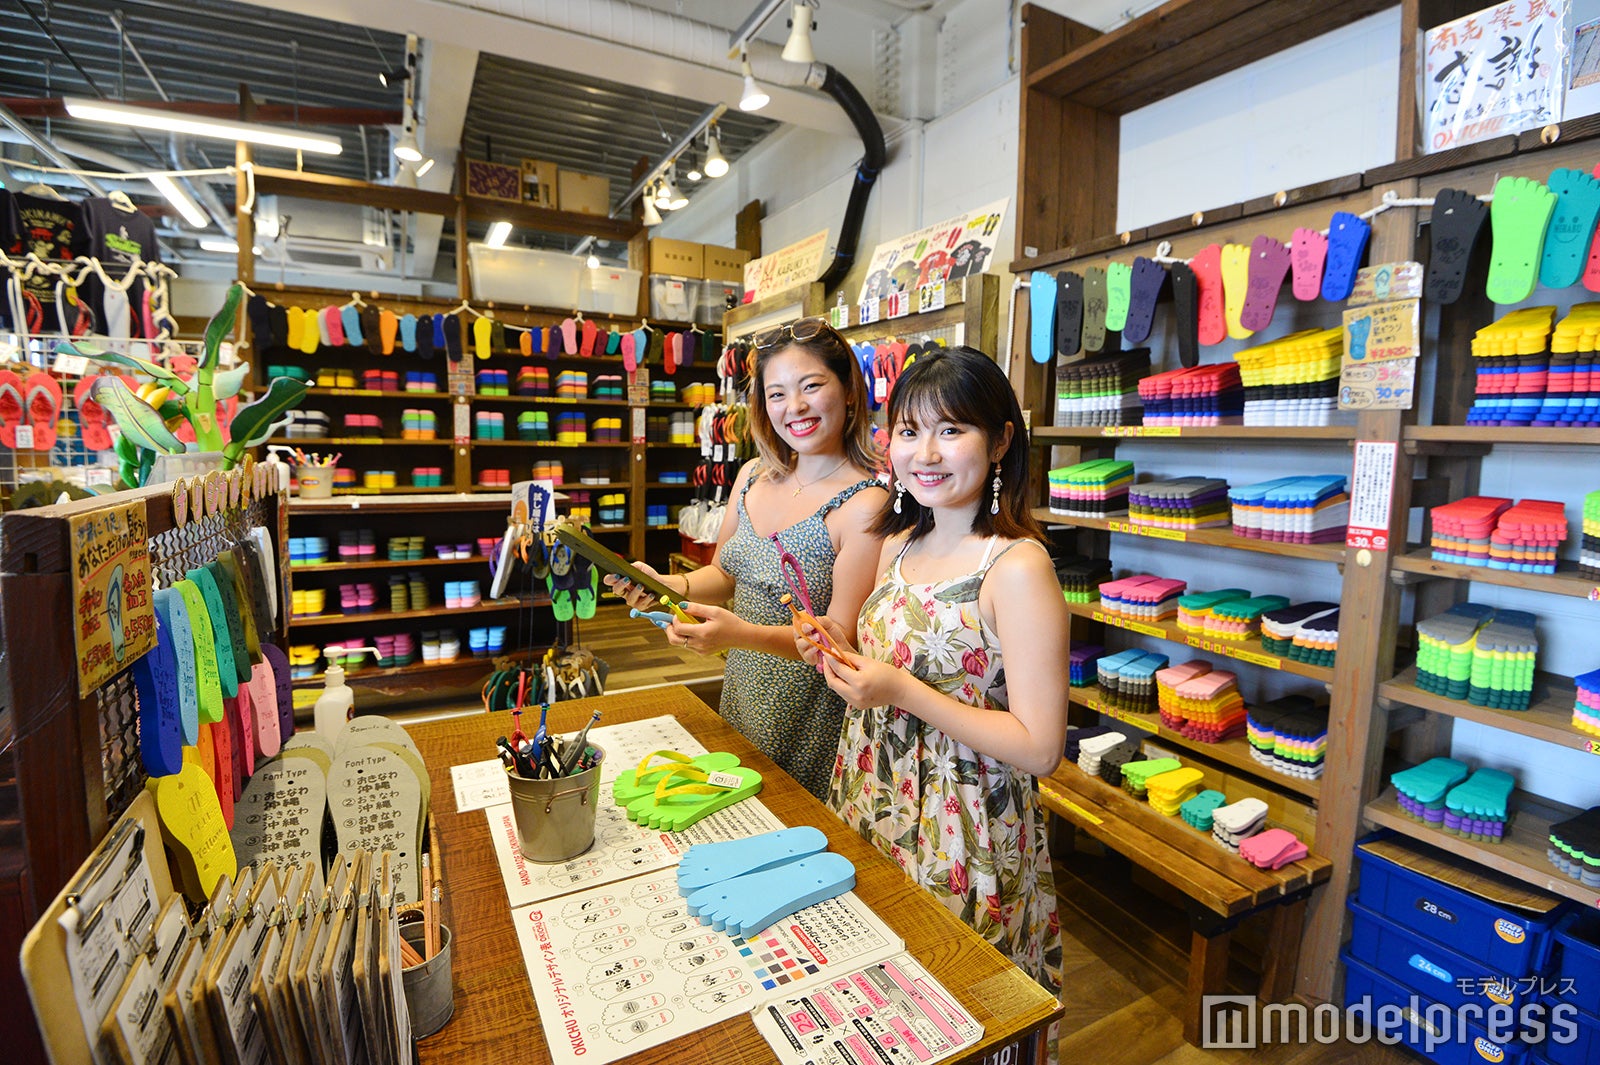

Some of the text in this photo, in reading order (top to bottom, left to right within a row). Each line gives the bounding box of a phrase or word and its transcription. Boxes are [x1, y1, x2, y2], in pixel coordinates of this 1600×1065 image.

[345, 756, 386, 769] Font Type
[263, 769, 307, 782] Font Type
[357, 771, 398, 785] おきなわ
[264, 786, 308, 801] おきなわ
[357, 781, 391, 794] 沖縄
[264, 798, 300, 811] 沖縄
[358, 791, 399, 804] おきなわ
[358, 800, 392, 813] 沖縄
[262, 807, 308, 821] おきなわ
[358, 810, 402, 825] おきなわ
[263, 816, 300, 831] 沖縄
[360, 820, 394, 835] 沖縄
[262, 829, 309, 843] おきなわ
[361, 831, 405, 848] おきなわ
[262, 838, 301, 853] 沖縄
[1423, 901, 1452, 921] 28 cm
[1498, 926, 1521, 939] ONLY
[1499, 920, 1524, 934] STAFF
[1418, 959, 1446, 979] 24 cm
[540, 941, 587, 1056] OKICHU オリジナルデザイン表
[856, 977, 884, 1006] OKINAWA
[859, 1006, 870, 1015] 5
[790, 1012, 815, 1033] 25
[883, 1036, 895, 1044] 6
[902, 1029, 918, 1044] 沖縄
[1477, 1044, 1501, 1058] ONLY
[1478, 1038, 1502, 1052] STAFF
